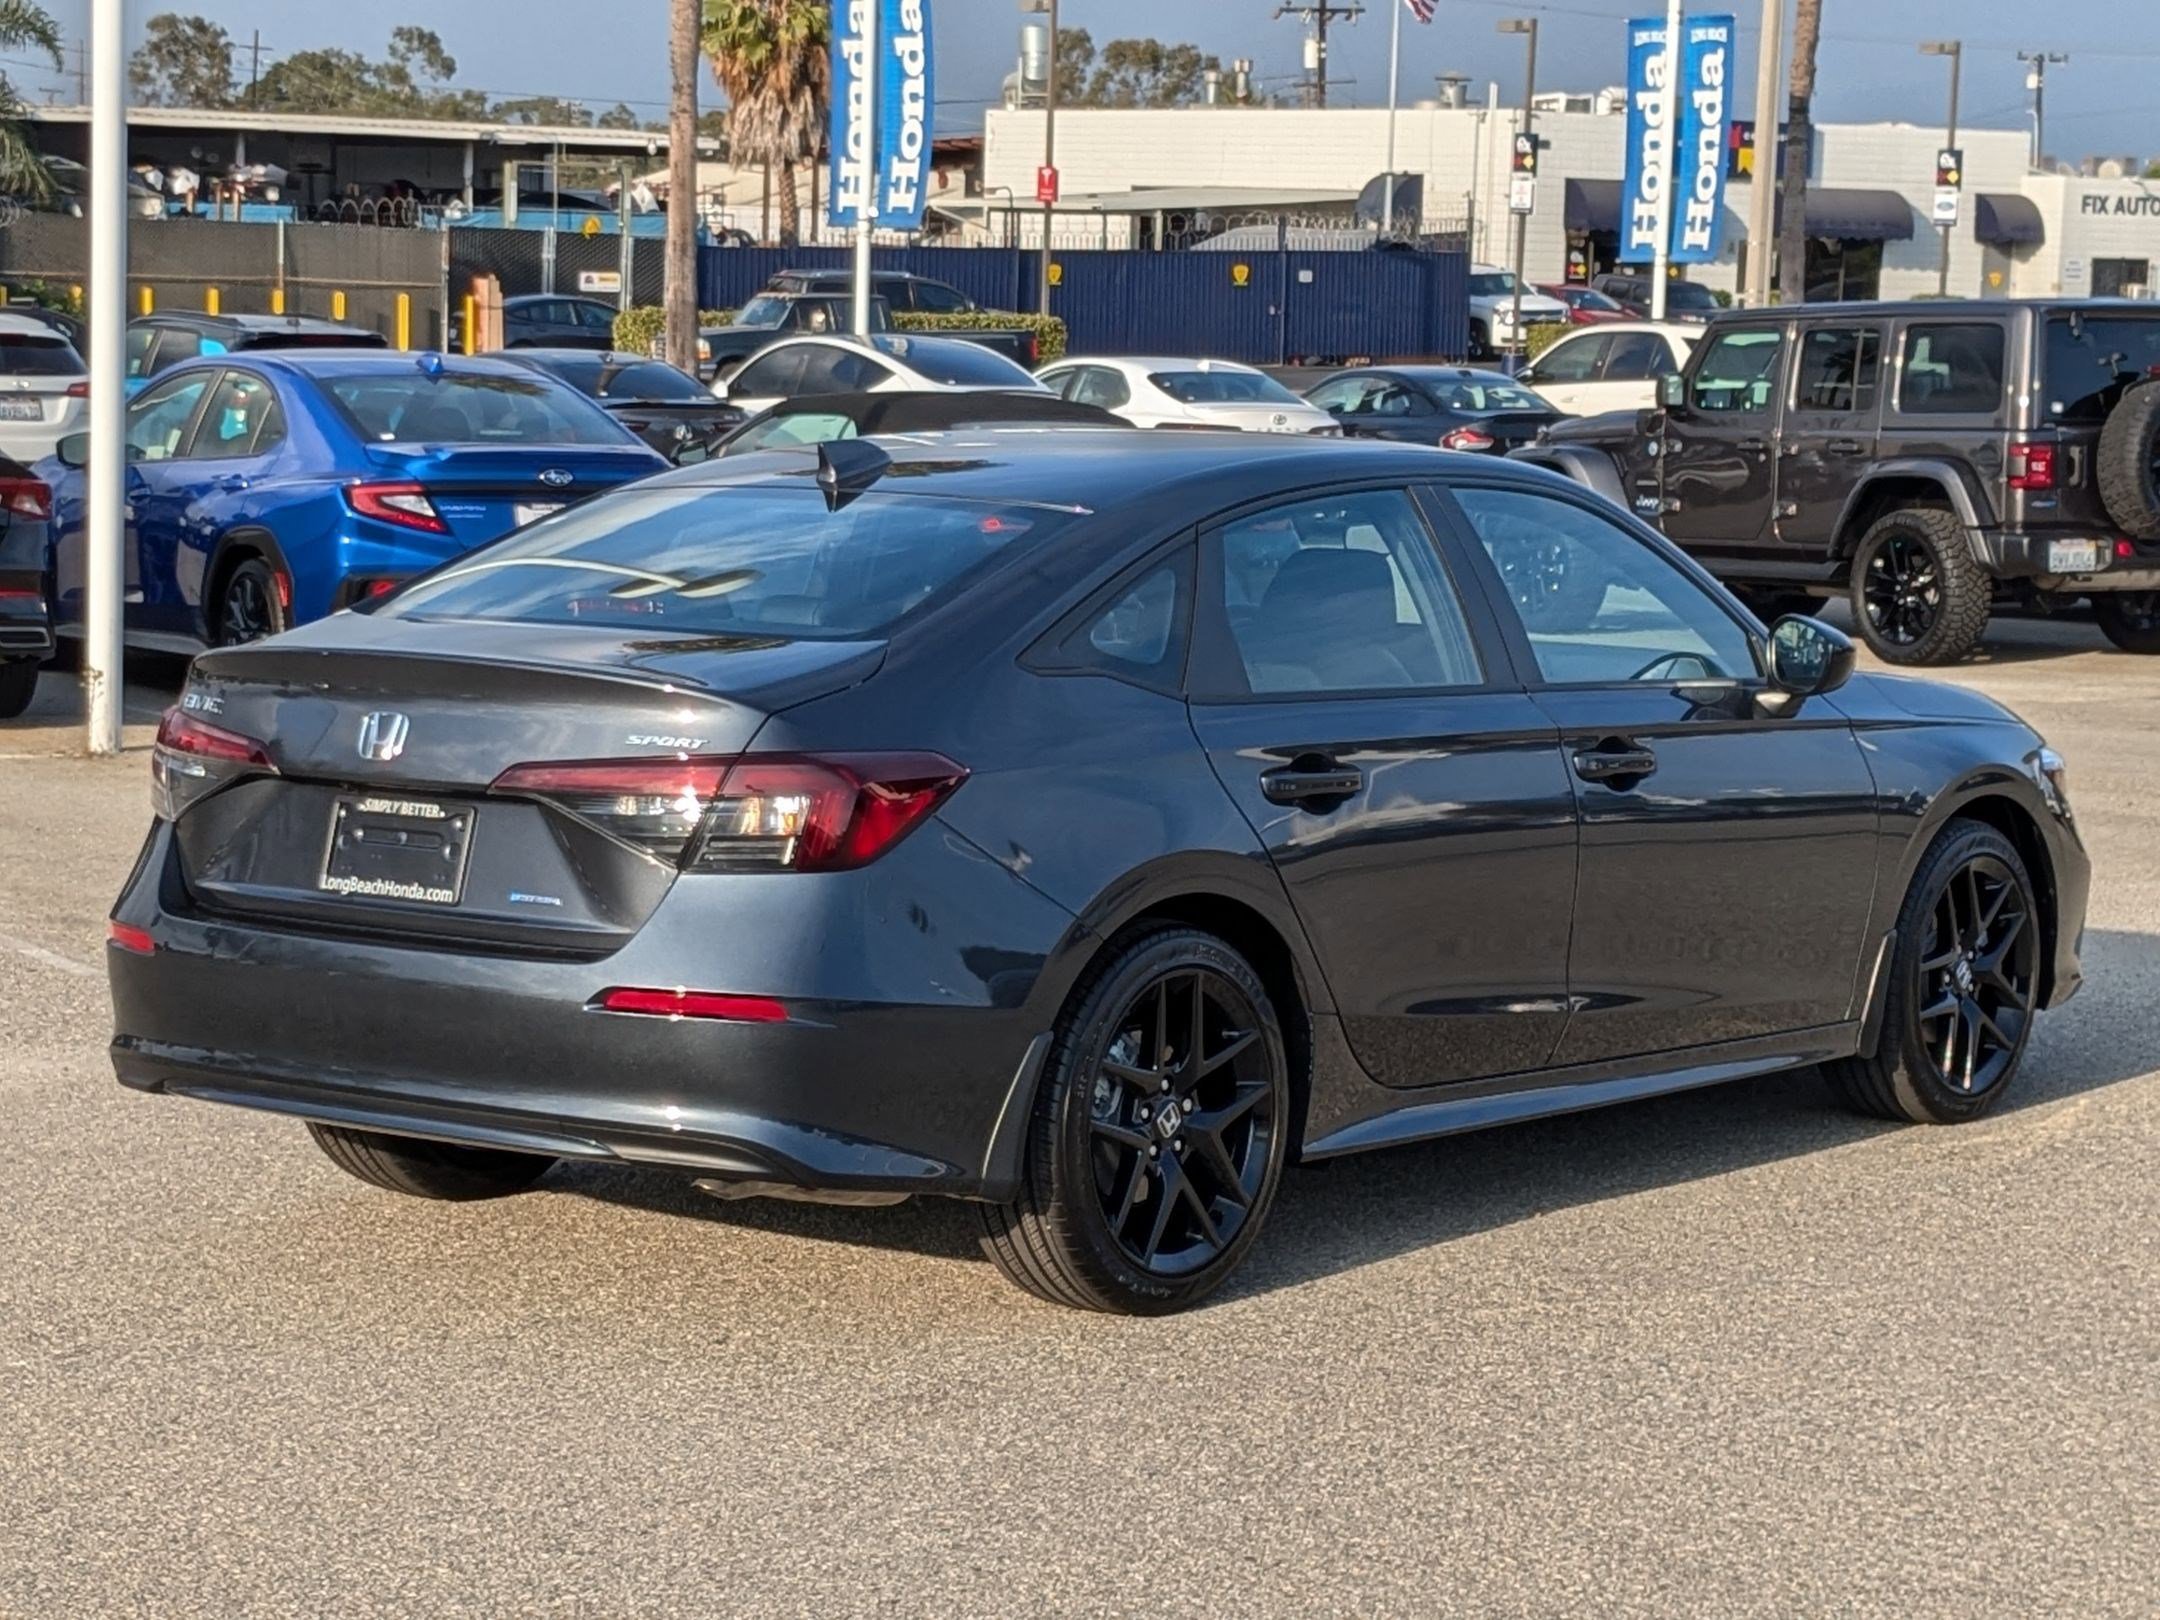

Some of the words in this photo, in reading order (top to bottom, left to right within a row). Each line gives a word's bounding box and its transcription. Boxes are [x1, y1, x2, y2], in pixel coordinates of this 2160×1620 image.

[887, 0, 925, 214] Honda
[1631, 50, 1666, 250] Honda
[1683, 47, 1724, 251] Honda
[2081, 194, 2109, 215] FIX
[2113, 195, 2160, 216] AUTO
[625, 735, 709, 749] SPORT
[364, 798, 402, 813] SIMPLY
[400, 801, 440, 818] BETTER
[321, 874, 453, 902] LongBeachHonda.com
